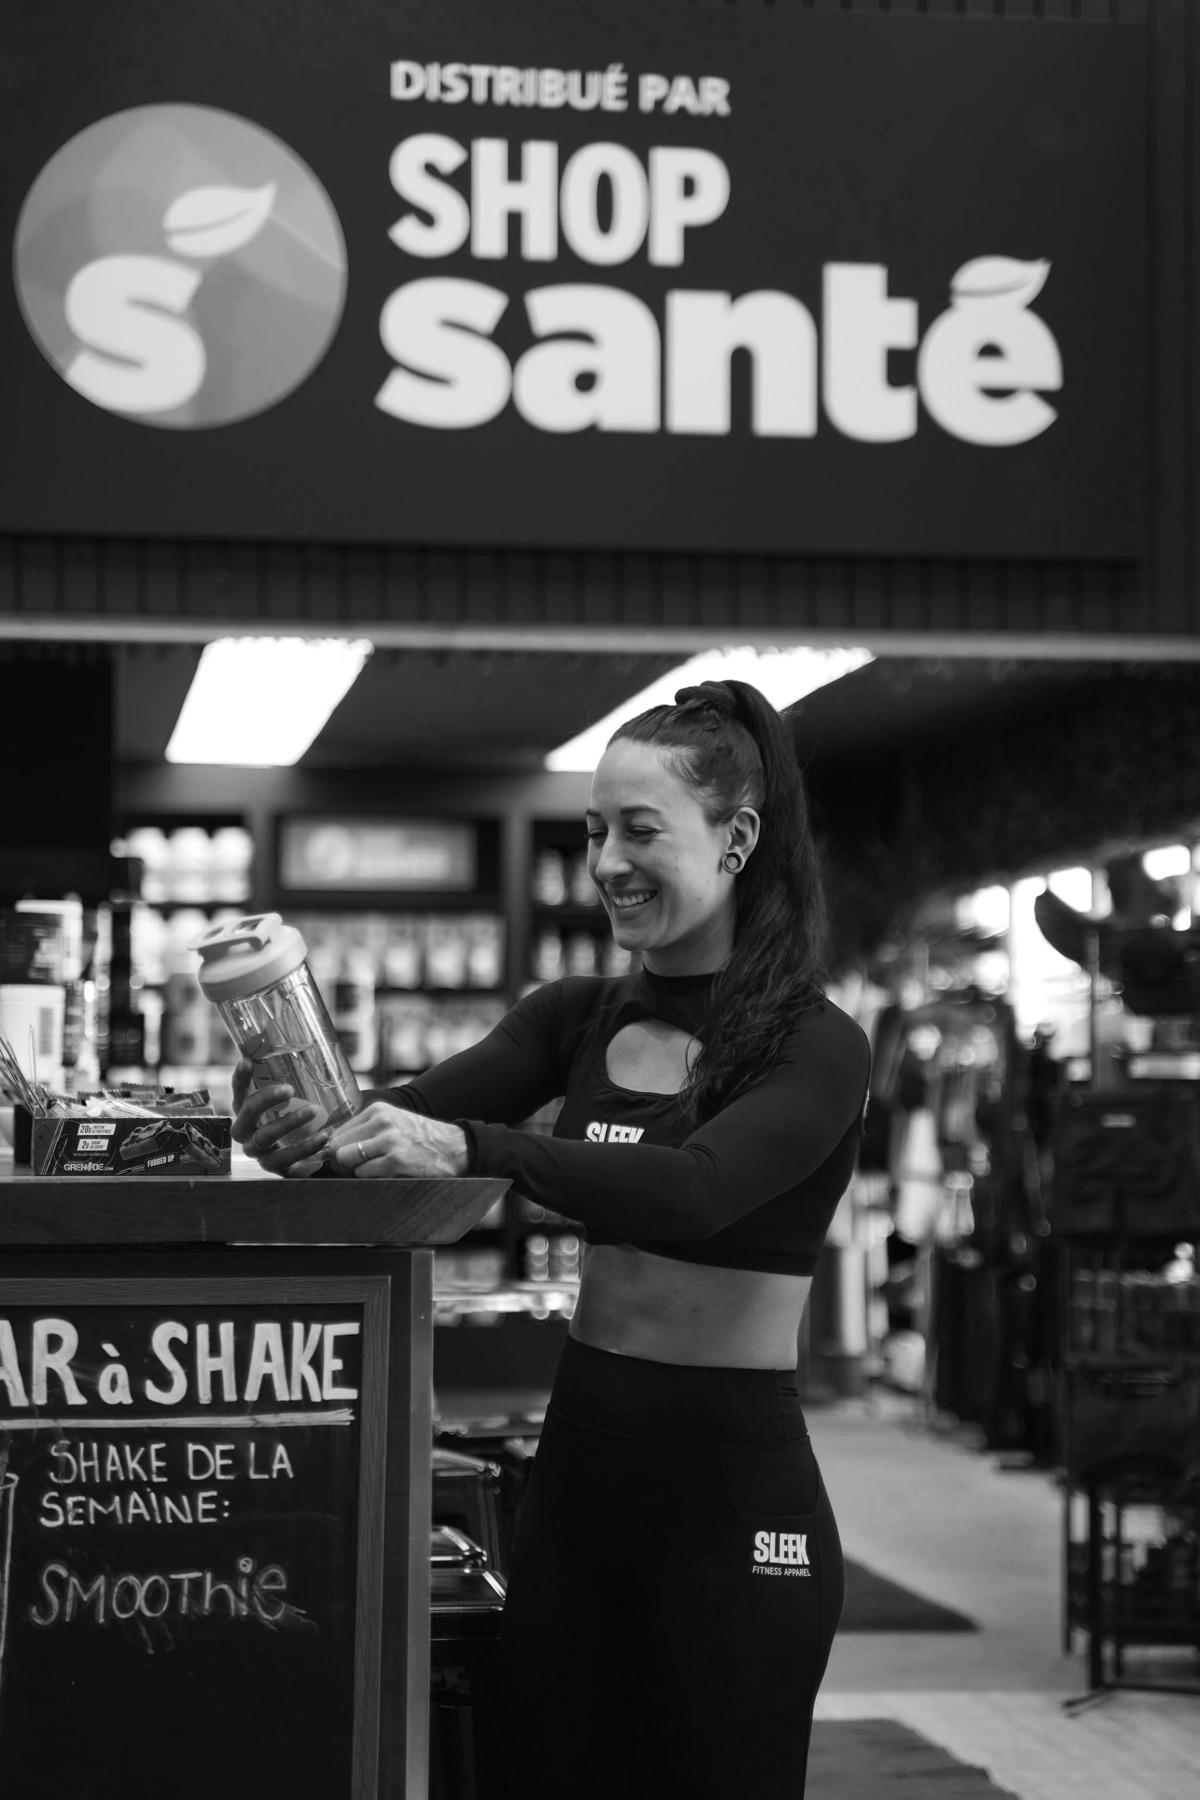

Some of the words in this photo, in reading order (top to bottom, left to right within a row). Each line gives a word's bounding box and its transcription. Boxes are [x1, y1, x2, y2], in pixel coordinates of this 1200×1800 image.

[389, 59, 629, 112] DISTRIBUÉ
[637, 72, 732, 117] PAR
[387, 132, 732, 268] SHOP
[372, 253, 1065, 447] santé
[147, 1156, 167, 1168] FUDGED
[167, 1154, 175, 1163] UP
[98, 1343, 133, 1405] à
[145, 1320, 360, 1405] SHAKE
[49, 1440, 169, 1484] SHAKE
[187, 1442, 236, 1481] DE
[248, 1441, 294, 1480] LA
[39, 1488, 231, 1528] SEMAINE:
[753, 1530, 810, 1565] SLEEK
[752, 1565, 782, 1576] FITNESS
[783, 1568, 811, 1577] APPAREL
